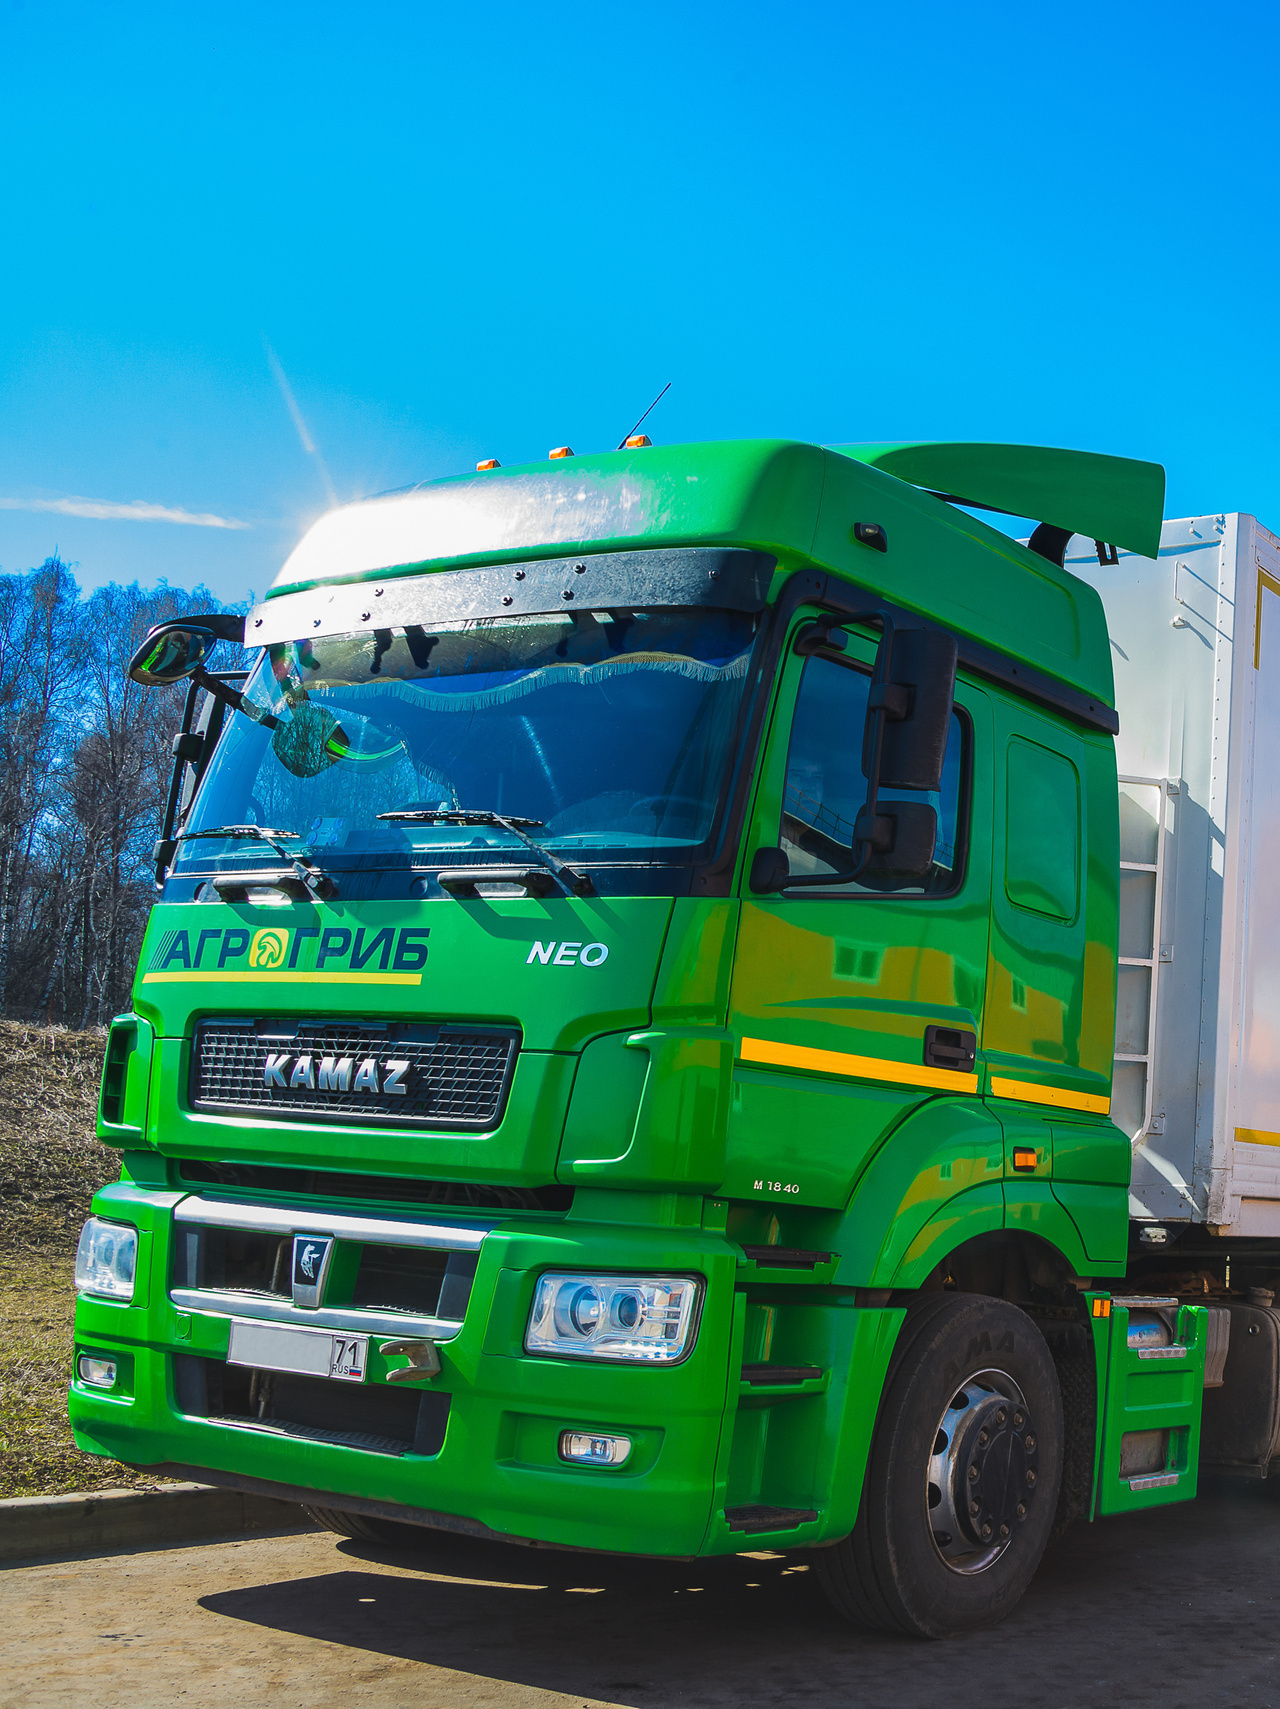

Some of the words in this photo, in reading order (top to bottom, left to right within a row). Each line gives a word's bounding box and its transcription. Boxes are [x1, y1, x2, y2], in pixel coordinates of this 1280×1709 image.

[150, 927, 431, 970] АГРОГРИБ
[525, 940, 610, 967] NEO
[264, 1053, 412, 1095] KAMAZ
[753, 1179, 763, 1190] M
[767, 1180, 800, 1194] 1840
[335, 1338, 359, 1366] 71
[332, 1363, 349, 1375] RUS
